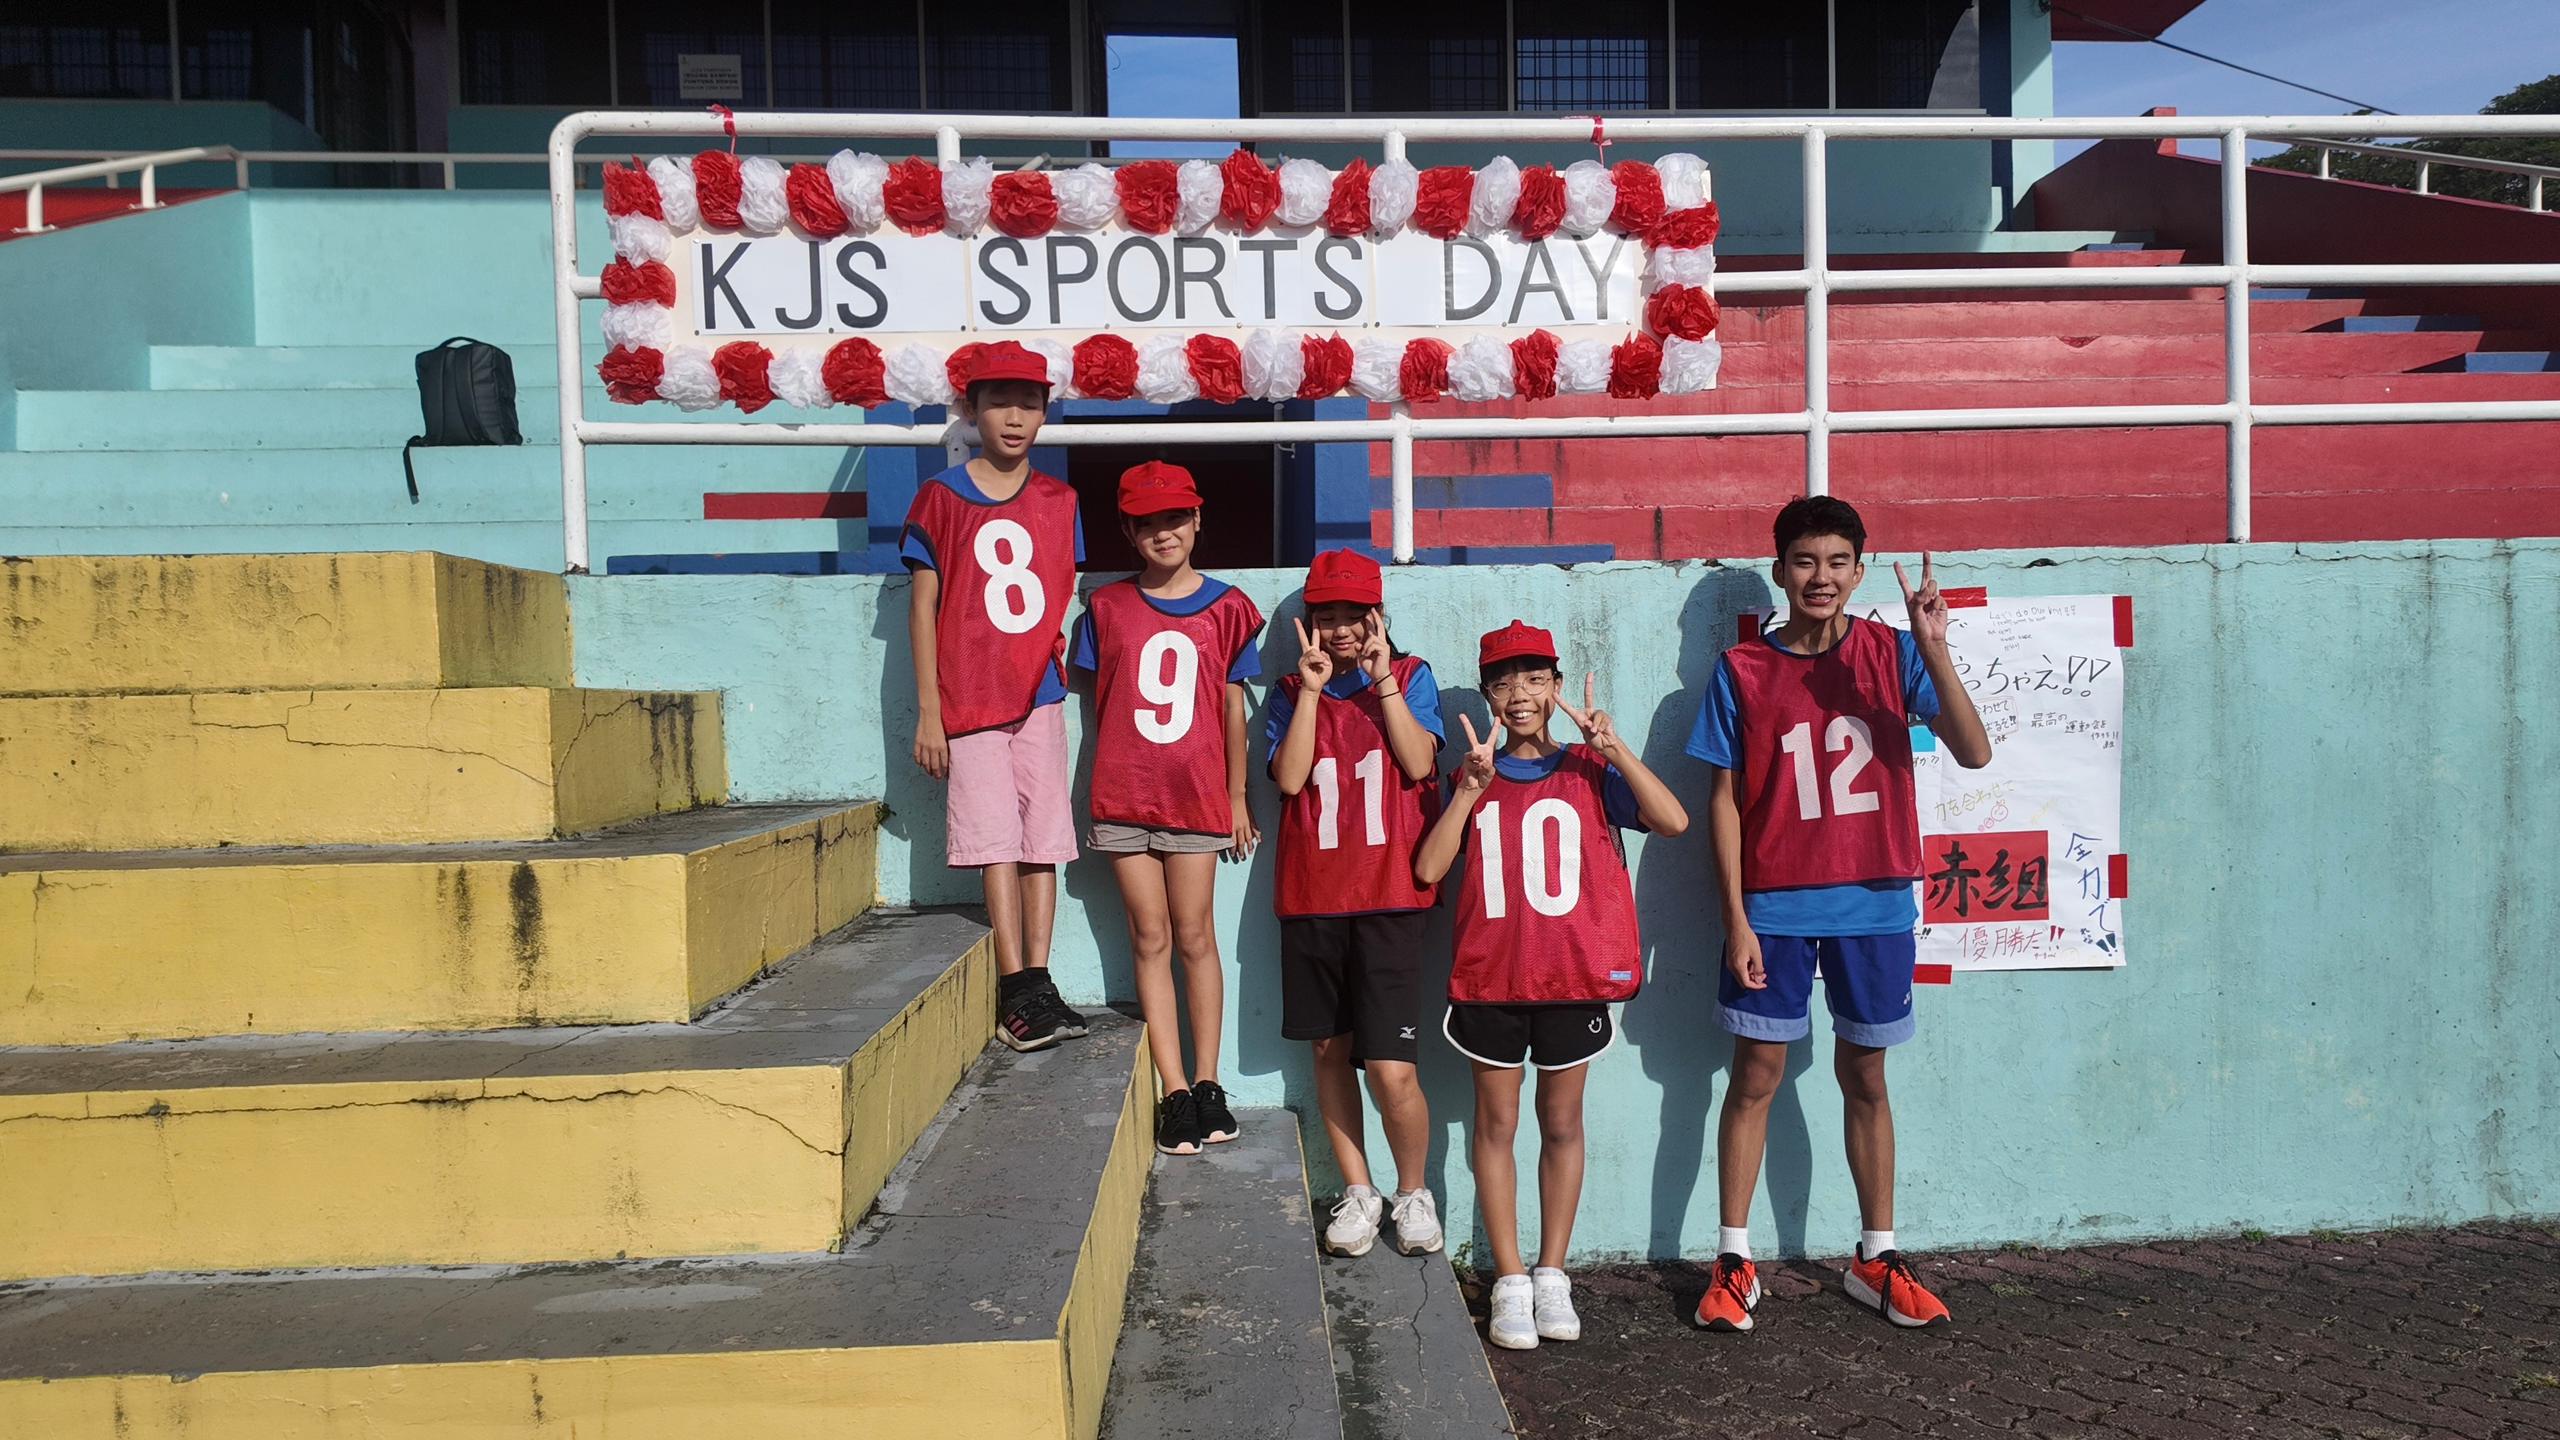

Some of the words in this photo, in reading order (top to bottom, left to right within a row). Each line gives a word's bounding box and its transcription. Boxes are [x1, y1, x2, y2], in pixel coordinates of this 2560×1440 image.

[700, 240, 888, 330] KJS
[977, 235, 1364, 326] SPORTS
[1443, 234, 1628, 324] DAY
[973, 518, 1046, 634] 8
[1134, 630, 1199, 745] 9
[2031, 712, 2068, 728] 最高の
[1312, 749, 1387, 851] 11
[1781, 714, 1880, 821] 12
[1934, 779, 2017, 822] 力を合わせて
[1475, 797, 1582, 919] 10
[1926, 840, 2049, 918] 赤組
